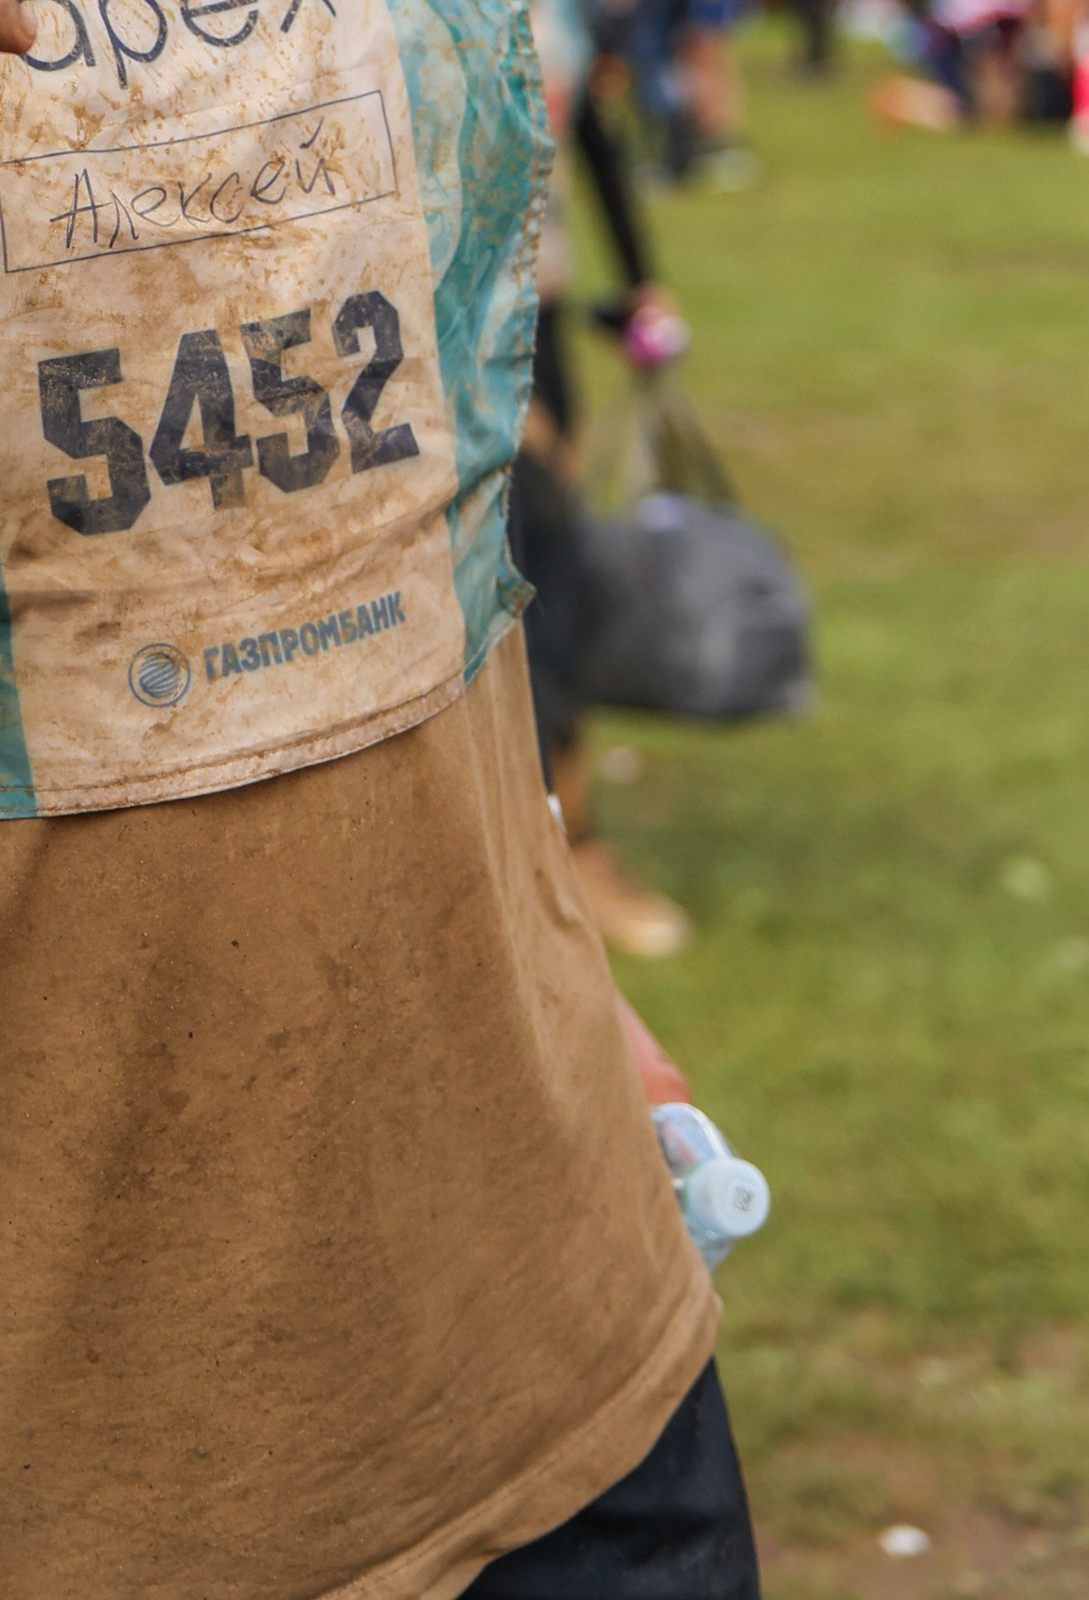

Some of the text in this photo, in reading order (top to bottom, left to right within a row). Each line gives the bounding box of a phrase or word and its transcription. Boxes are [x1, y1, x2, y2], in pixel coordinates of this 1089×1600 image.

[49, 117, 337, 250] Алексей
[37, 290, 420, 536] 5452
[202, 591, 406, 681] ГАЗПРОМБАНК
